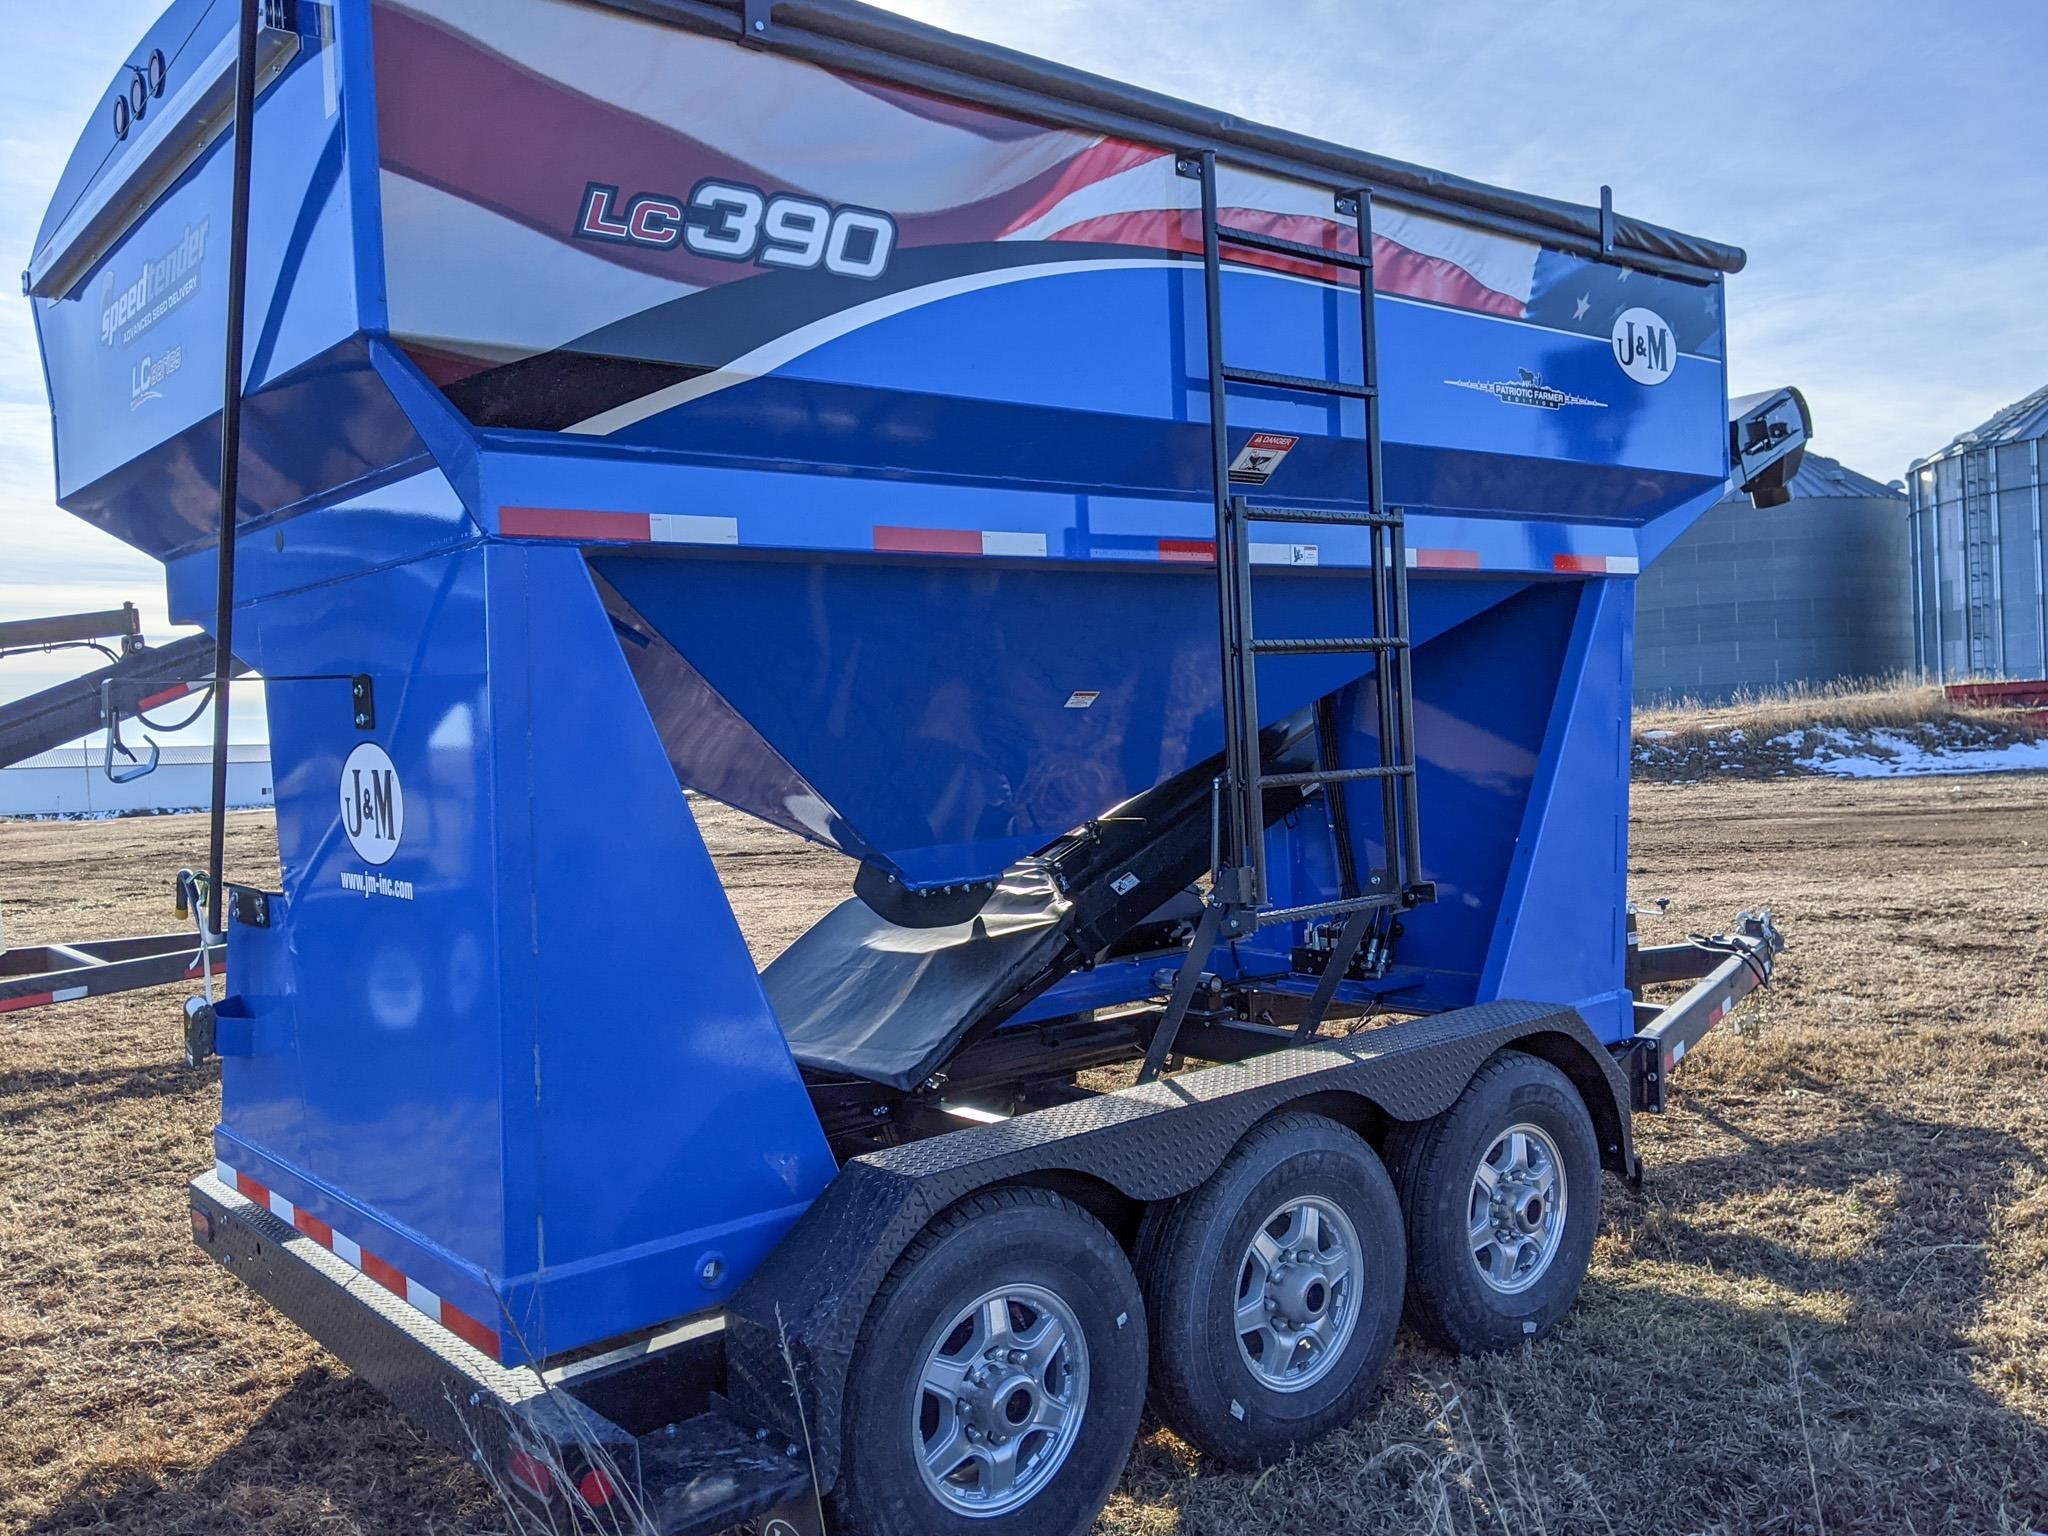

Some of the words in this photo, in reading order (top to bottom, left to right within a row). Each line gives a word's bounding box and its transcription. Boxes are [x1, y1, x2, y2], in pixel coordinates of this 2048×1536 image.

[123, 310, 152, 344] ADVANCED
[152, 299, 167, 321] SEED
[168, 274, 198, 306] DELIVERY
[1617, 321, 1668, 372] J&M
[1496, 385, 1533, 399] PATRIOTIC
[1534, 391, 1564, 402] FARMER
[1263, 435, 1292, 446] DANGER
[345, 769, 396, 841] J&M
[340, 871, 414, 901] www.jm-inc.com
